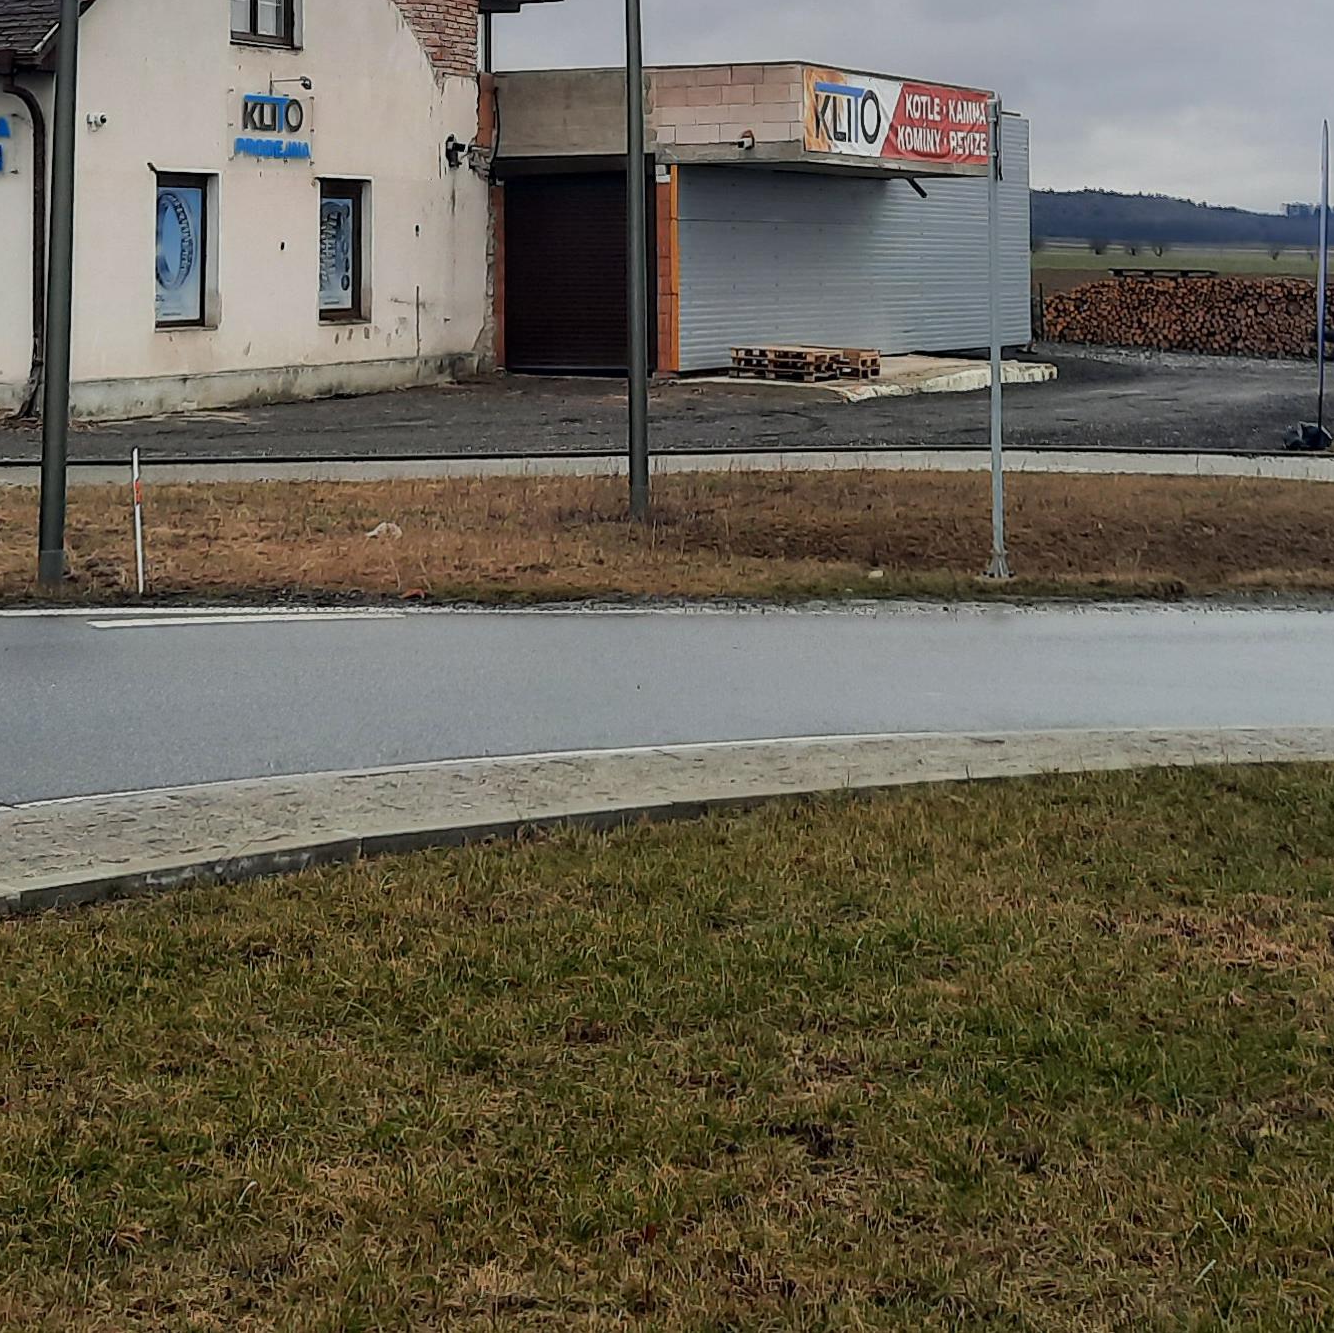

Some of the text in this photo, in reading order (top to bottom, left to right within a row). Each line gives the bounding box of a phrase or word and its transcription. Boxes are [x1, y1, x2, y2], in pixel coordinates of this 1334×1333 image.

[243, 94, 303, 132] KLITO
[815, 82, 882, 144] KLITO
[905, 93, 941, 122] KOTLE
[896, 122, 988, 156] KOMÍNY REVIZE
